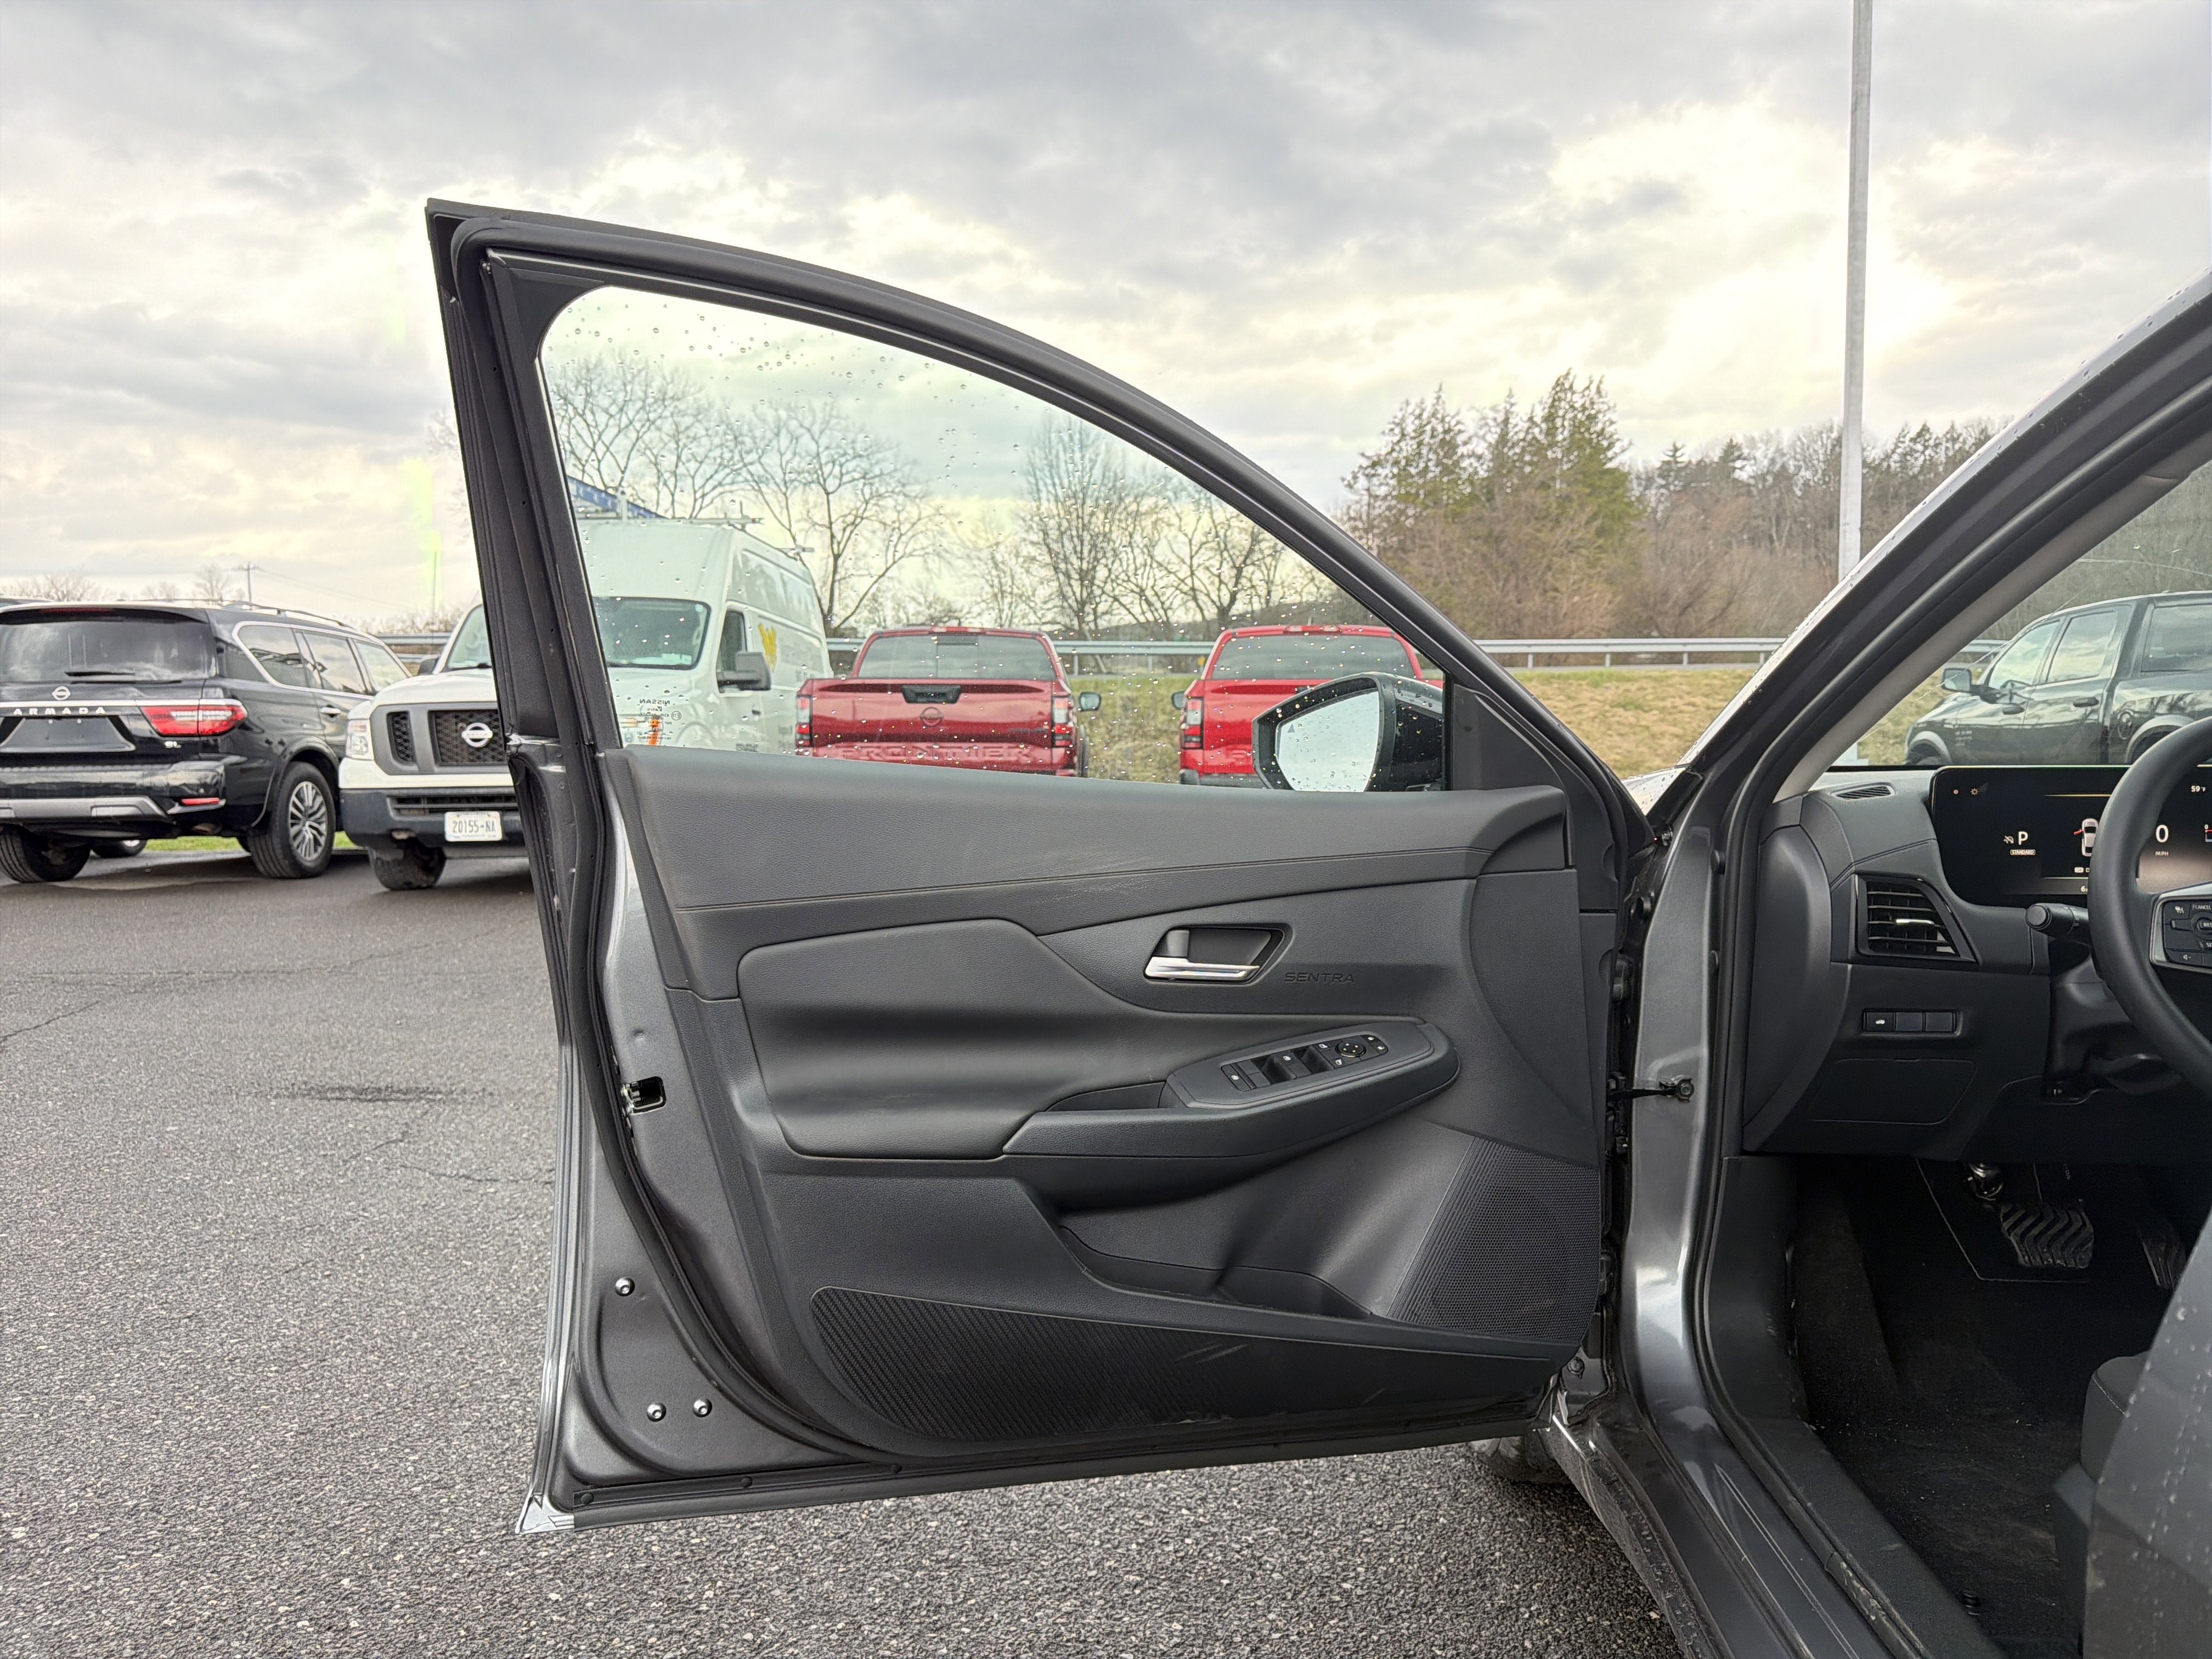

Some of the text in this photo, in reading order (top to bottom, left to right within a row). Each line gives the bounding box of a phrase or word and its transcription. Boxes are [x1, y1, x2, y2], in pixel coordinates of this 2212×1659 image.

[14, 706, 106, 715] ARMADA
[836, 745, 1032, 761] FRONTIER
[453, 820, 495, 833] 20155-NA
[2018, 831, 2028, 845] P
[2156, 825, 2169, 843] 0
[1284, 972, 1354, 983] SENTRA
